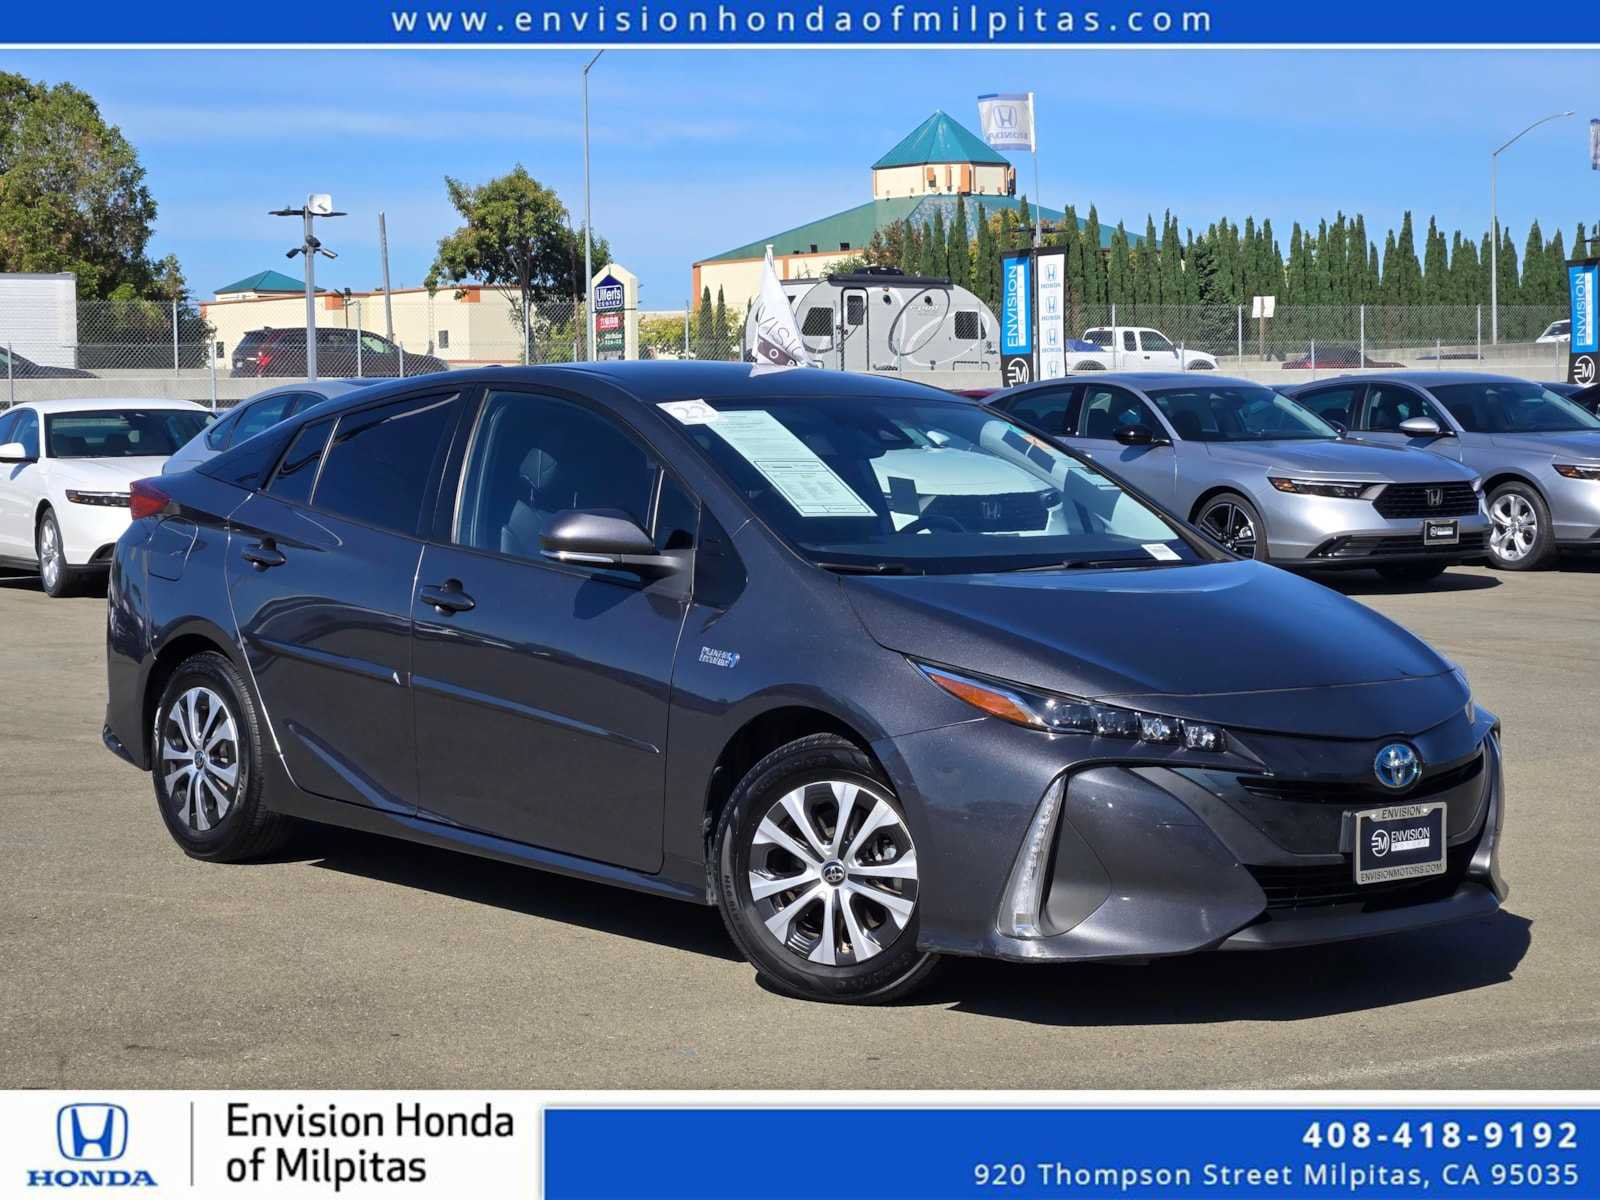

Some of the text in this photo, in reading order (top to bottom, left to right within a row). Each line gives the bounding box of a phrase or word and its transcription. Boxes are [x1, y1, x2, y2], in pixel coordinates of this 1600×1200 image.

[1007, 265, 1018, 348] ENVISION
[1575, 273, 1586, 346] ENVISION
[1382, 806, 1421, 819] ENVISION
[1391, 827, 1430, 842] ENVISION
